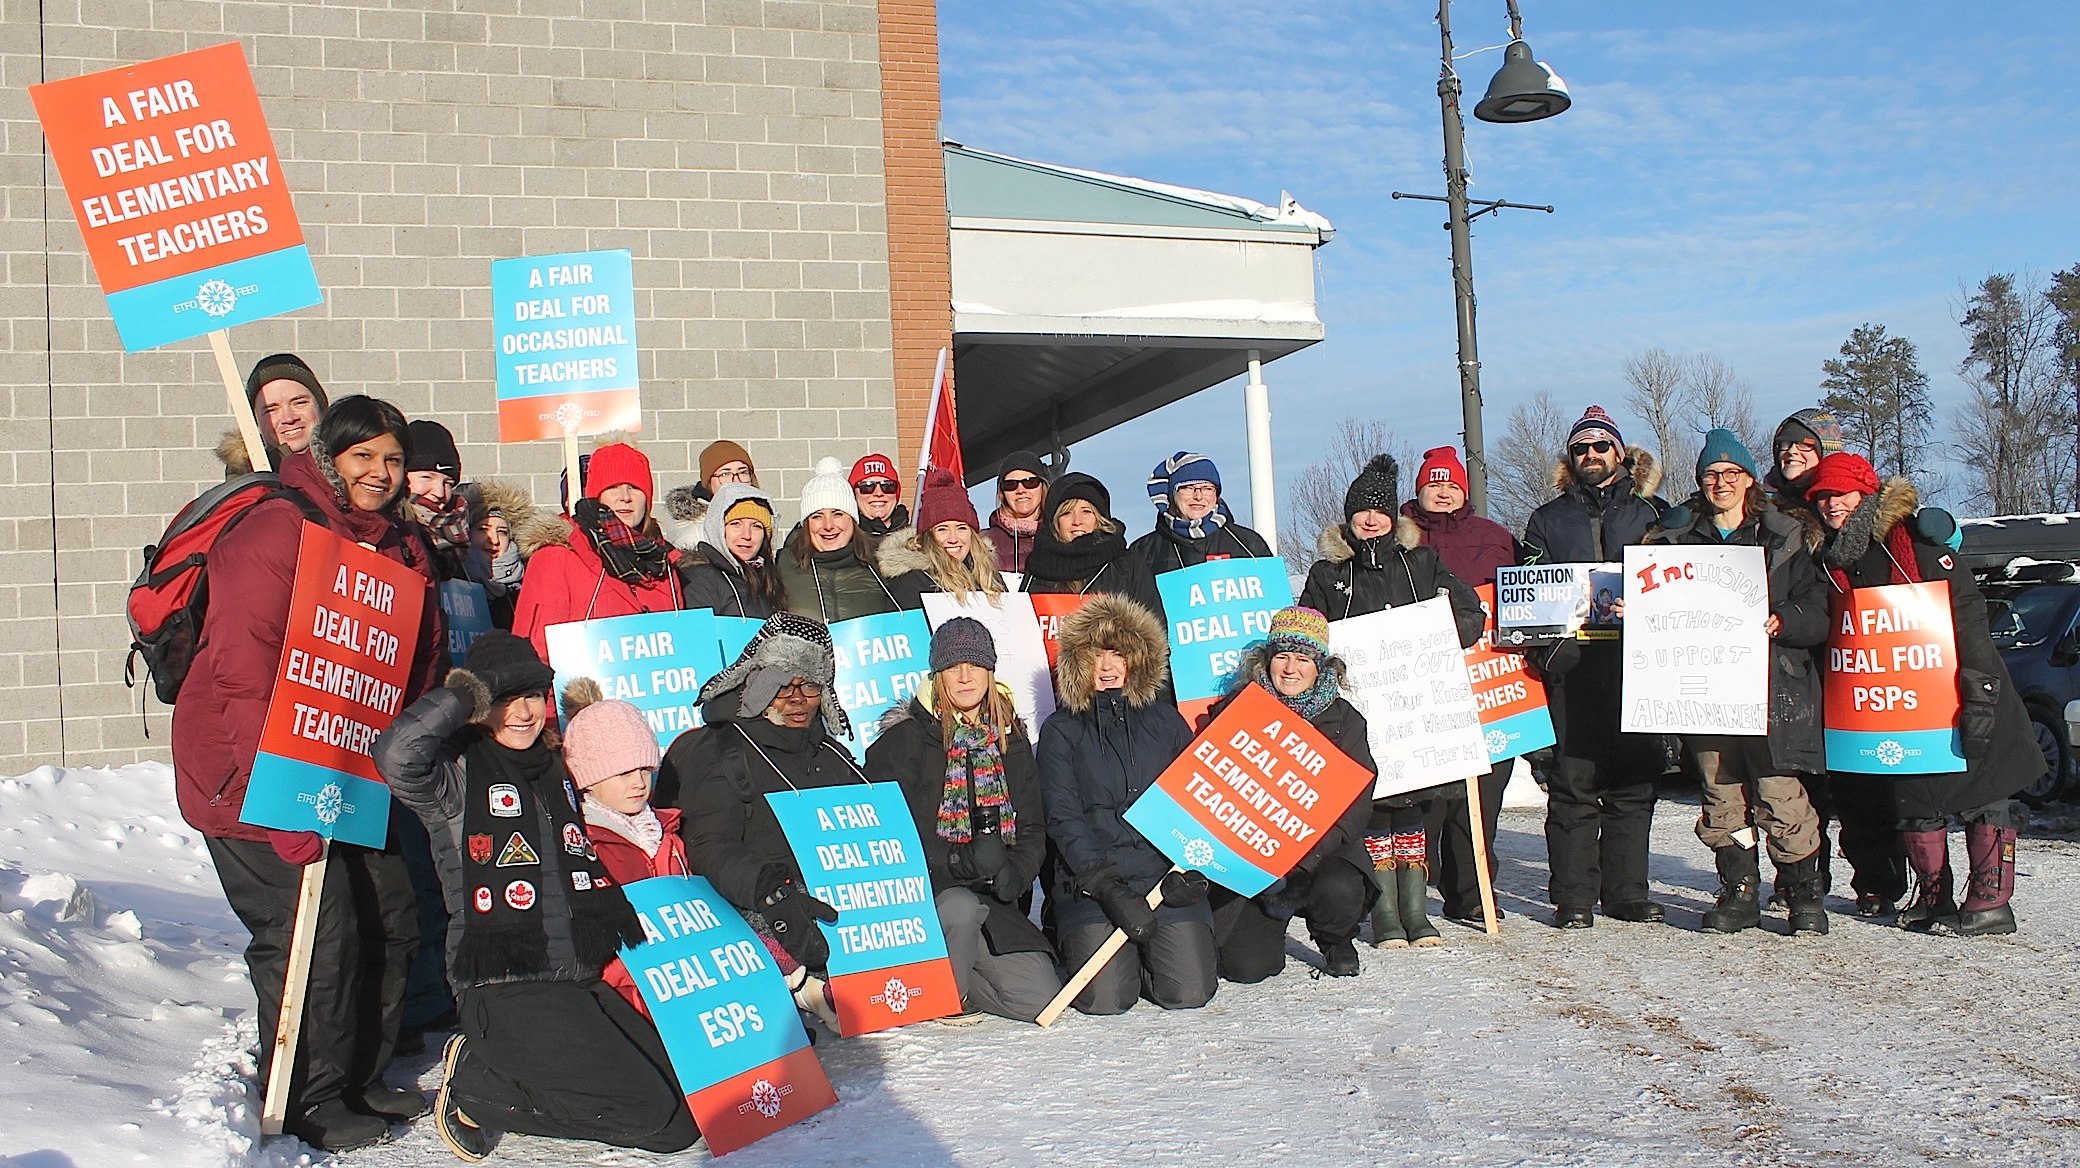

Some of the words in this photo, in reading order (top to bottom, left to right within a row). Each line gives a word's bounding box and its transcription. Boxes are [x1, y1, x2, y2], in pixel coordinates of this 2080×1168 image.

[101, 96, 127, 128] A
[127, 79, 201, 121] FAIR
[91, 135, 174, 178] DEAL
[174, 119, 237, 158] FOR
[81, 156, 271, 229] ELEMENTARY
[117, 205, 270, 267] TEACHERS
[529, 268, 543, 289] A
[549, 264, 594, 287] FAIR
[173, 300, 199, 314] ETFO
[515, 298, 566, 322] DEAL
[571, 294, 611, 317] FOR
[502, 325, 629, 355] OCCASIONAL
[515, 357, 618, 386] TEACHERS
[863, 461, 886, 475] ETFO
[1429, 468, 1451, 482] ETFO
[333, 564, 348, 597] A
[352, 570, 395, 616] FAIR
[1189, 583, 1206, 608] A
[1210, 576, 1264, 603] FAIR
[1501, 568, 1574, 586] EDUCATION
[1501, 587, 1536, 603] CUTS
[1538, 585, 1574, 601] HURT
[1502, 605, 1537, 622] KIDS.
[1644, 610, 1743, 633] WITHOUT
[1841, 610, 1855, 635] A
[312, 604, 361, 653] DEAL
[365, 625, 400, 667] FOR
[448, 629, 467, 653] EAL
[1176, 614, 1239, 645] DEAL
[597, 639, 616, 664] A
[620, 631, 675, 662] FAIR
[834, 645, 852, 671] A
[855, 634, 913, 667] FAIR
[1632, 646, 1751, 669] SUPPORT
[1830, 647, 1886, 674] DEAL
[1892, 643, 1943, 672] FOR
[285, 648, 402, 716] ELEMENTARY
[602, 673, 646, 700] EAL
[651, 667, 699, 695] FOR
[1350, 664, 1408, 689] ALKING
[1414, 648, 1461, 677] OUT
[838, 679, 888, 710] EAL
[1853, 685, 1918, 712] PSPs
[1421, 708, 1478, 734] WALKING
[1262, 719, 1283, 741] A
[1279, 731, 1327, 777] FAIR
[1413, 742, 1478, 768] THEM
[1859, 749, 1876, 757] ETFO
[1228, 729, 1280, 779] DEAL
[1276, 769, 1320, 811] FOR
[296, 792, 316, 805] ETFO
[1193, 740, 1316, 844] ELEMENTARY
[816, 807, 836, 832] A
[832, 803, 880, 831] FAIR
[1184, 772, 1281, 858] TEACHERS
[816, 843, 869, 872] DEAL
[868, 838, 906, 866] FOR
[814, 876, 926, 913] ELEMENTARY
[637, 913, 665, 946] A
[657, 899, 722, 940] FAIR
[837, 917, 927, 954] TEACHERS
[644, 954, 718, 1003] DEAL
[711, 940, 766, 983] FOR
[870, 995, 885, 1005] ETFO
[698, 1002, 765, 1049] ESPs
[738, 1102, 755, 1115] ETFO
